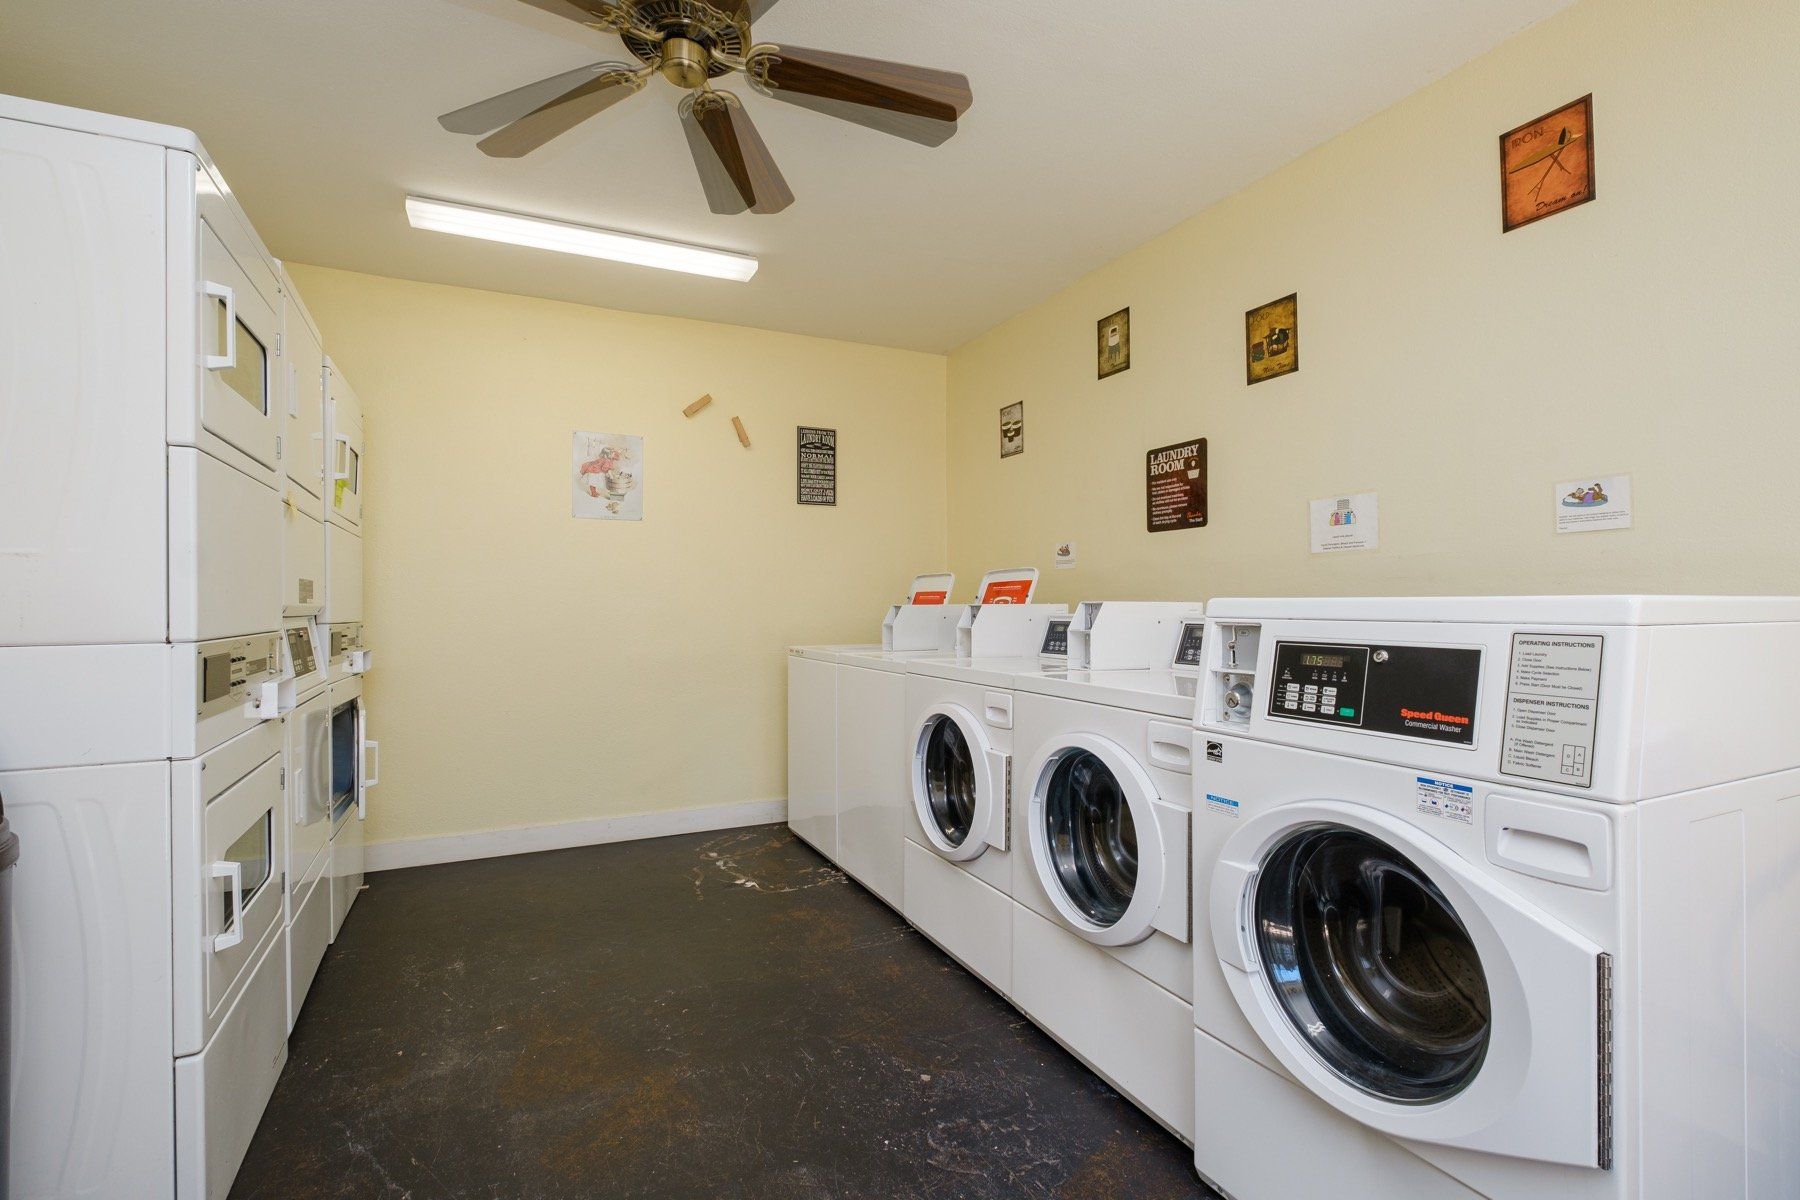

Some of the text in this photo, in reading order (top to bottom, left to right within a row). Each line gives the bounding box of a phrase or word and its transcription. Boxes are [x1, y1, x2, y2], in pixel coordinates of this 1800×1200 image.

[1150, 445, 1199, 465] LAUNDRY
[1150, 459, 1185, 476] ROOM
[1513, 698, 1590, 710] DISPENSER INSTRUCTIONS
[1401, 709, 1469, 724] Speed Queen
[1405, 720, 1461, 732] Commercial Washer
